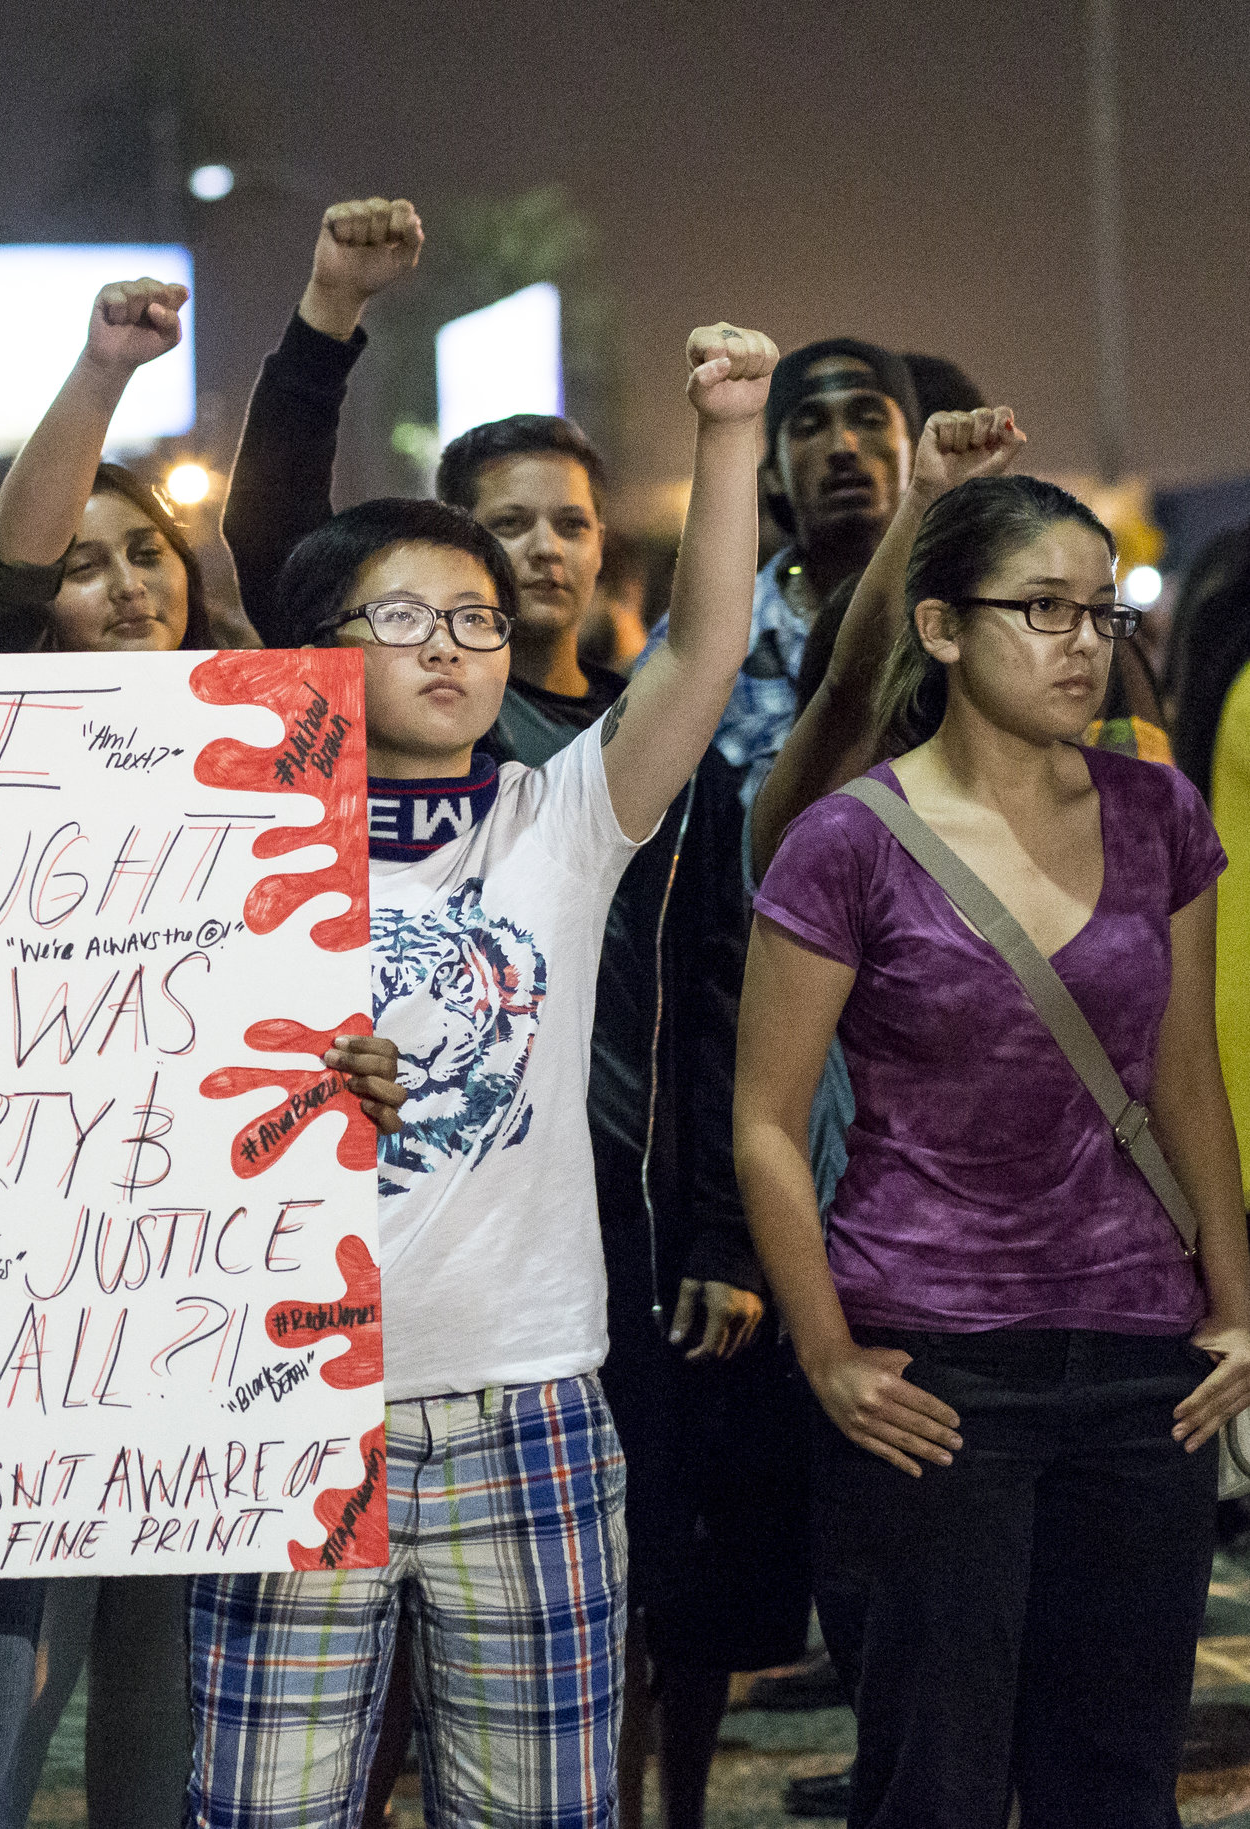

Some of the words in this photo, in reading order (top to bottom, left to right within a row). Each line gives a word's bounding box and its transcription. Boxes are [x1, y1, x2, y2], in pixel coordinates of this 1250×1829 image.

[11, 951, 211, 1068] WAS
[25, 1199, 325, 1302] JUSTICE
[96, 1441, 286, 1515] AWARE
[282, 1437, 351, 1498] OF
[0, 1519, 108, 1571] FINE
